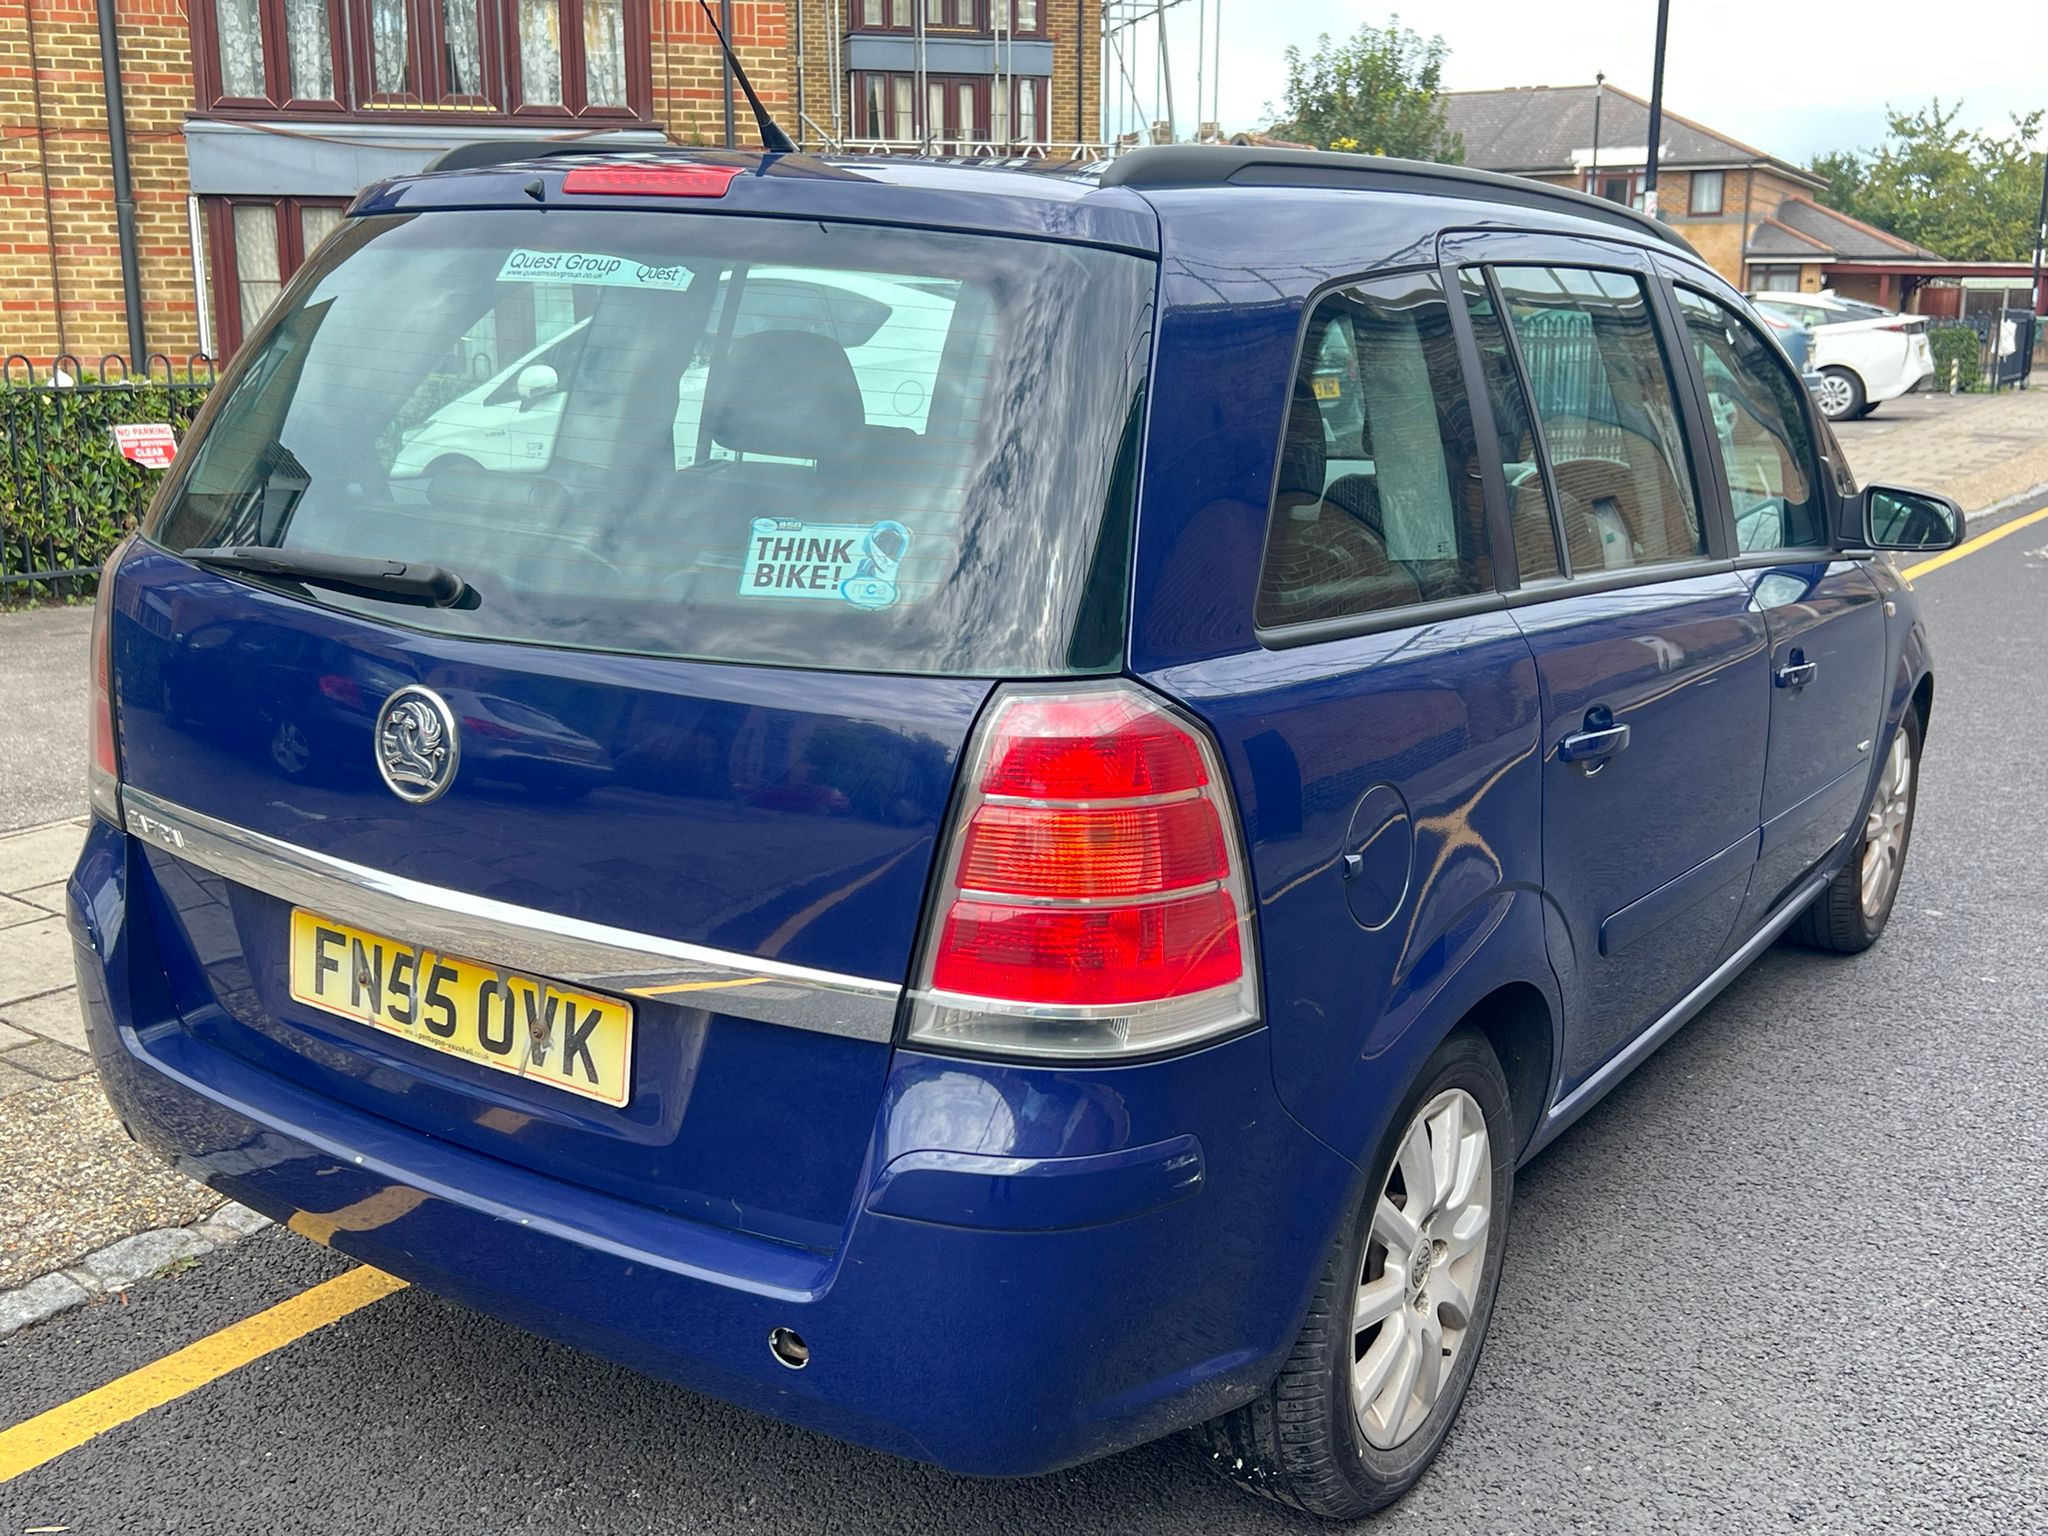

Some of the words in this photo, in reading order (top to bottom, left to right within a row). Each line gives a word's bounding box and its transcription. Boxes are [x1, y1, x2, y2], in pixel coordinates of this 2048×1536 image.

[509, 252, 563, 269] Quest
[565, 254, 622, 276] Group
[636, 265, 680, 283] Quest
[117, 428, 131, 437] NO
[132, 427, 170, 436] PARKING
[135, 447, 165, 457] CLEAR
[756, 536, 856, 564] THINK
[753, 563, 843, 590] BIKE!
[314, 926, 458, 1039] FN55
[478, 978, 603, 1085] OVK
